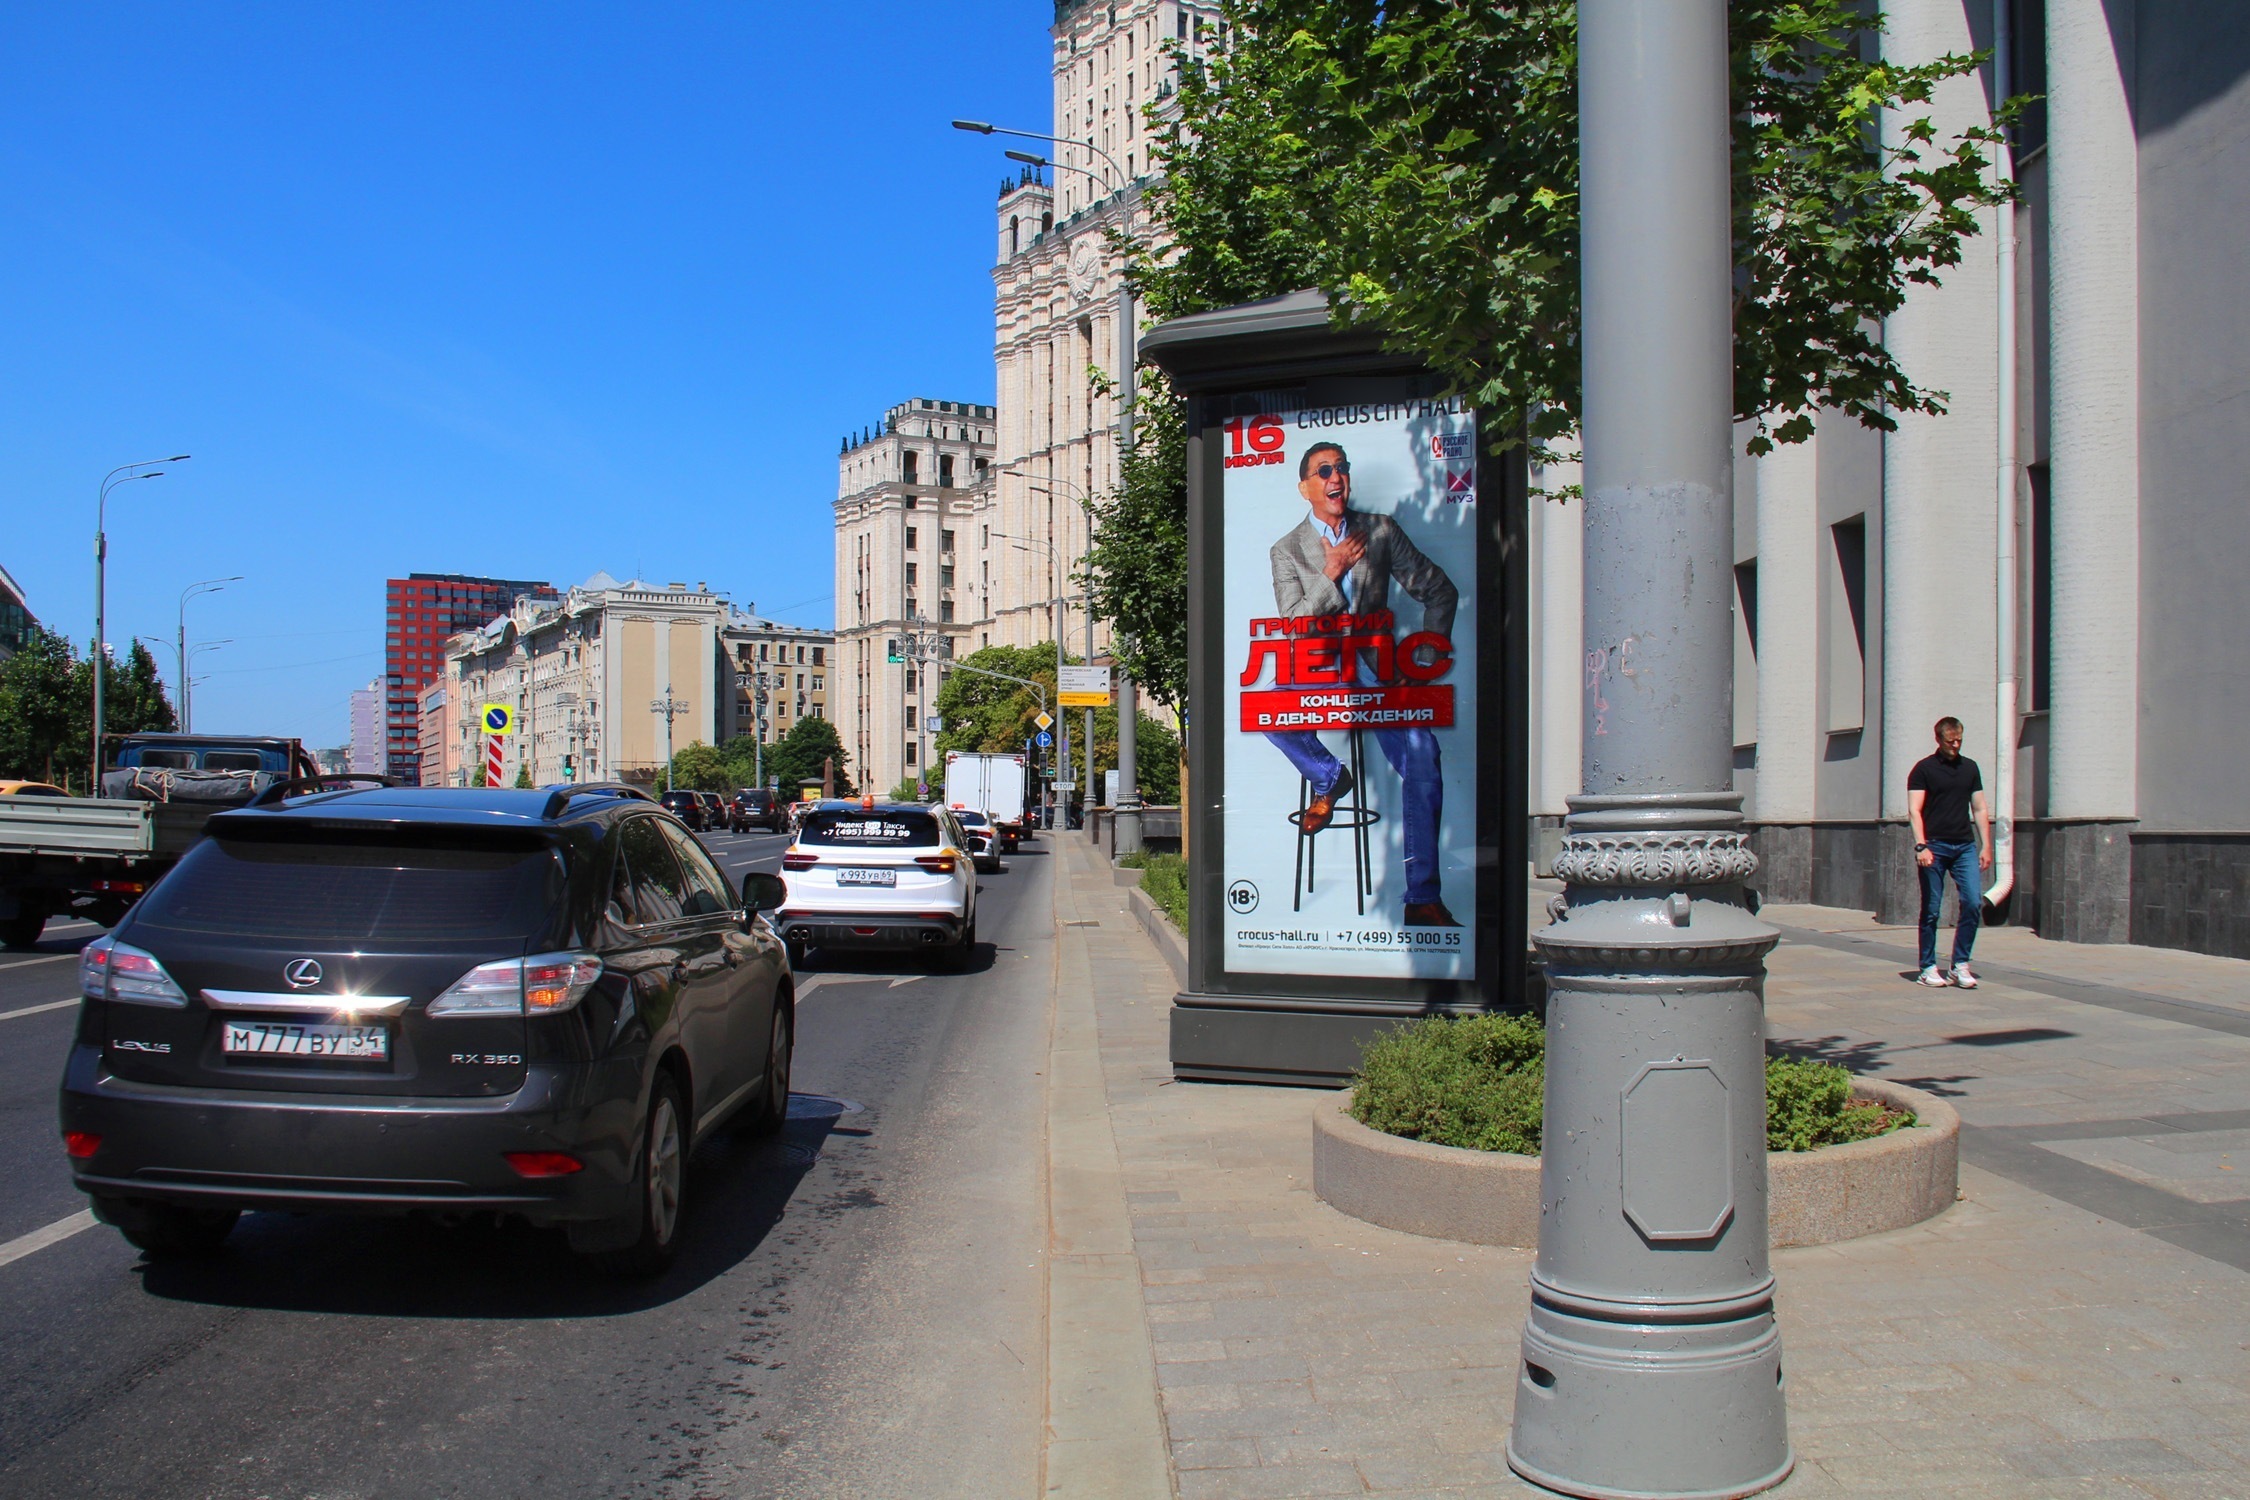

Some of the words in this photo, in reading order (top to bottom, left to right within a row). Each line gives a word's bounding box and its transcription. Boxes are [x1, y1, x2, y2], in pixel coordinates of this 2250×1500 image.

[1297, 404, 1370, 429] CROCUS
[1373, 401, 1414, 421] CITY
[1418, 394, 1471, 418] HALL
[1224, 413, 1285, 455] 16
[1443, 435, 1469, 447] РУССКОЕ
[1443, 446, 1462, 457] РАДИО
[1224, 451, 1285, 469] ИЮЛЯ
[1446, 494, 1474, 504] МУЗ
[1249, 609, 1394, 637] ГРИГОРИЙ
[1240, 631, 1454, 687] ЛЕПС
[1300, 693, 1385, 708] КОНЦЕРТ
[1258, 713, 1272, 726] В
[1275, 712, 1324, 726] ДЕНЬ
[1327, 708, 1434, 724] РОЖДЕНИЯ
[835, 829, 862, 837] (495)
[883, 821, 906, 830] Такси
[1230, 889, 1256, 905] 18+
[1237, 929, 1319, 942] crocus-hall.ru
[1337, 931, 1353, 943] +7
[1357, 931, 1393, 945] (499)
[1397, 932, 1412, 944] 55
[1416, 932, 1441, 945] 000
[1445, 933, 1460, 945] 55
[351, 1027, 378, 1048] 34
[113, 1039, 171, 1053] LEXUS
[451, 1054, 480, 1064] RX
[483, 1054, 522, 1065] 350
